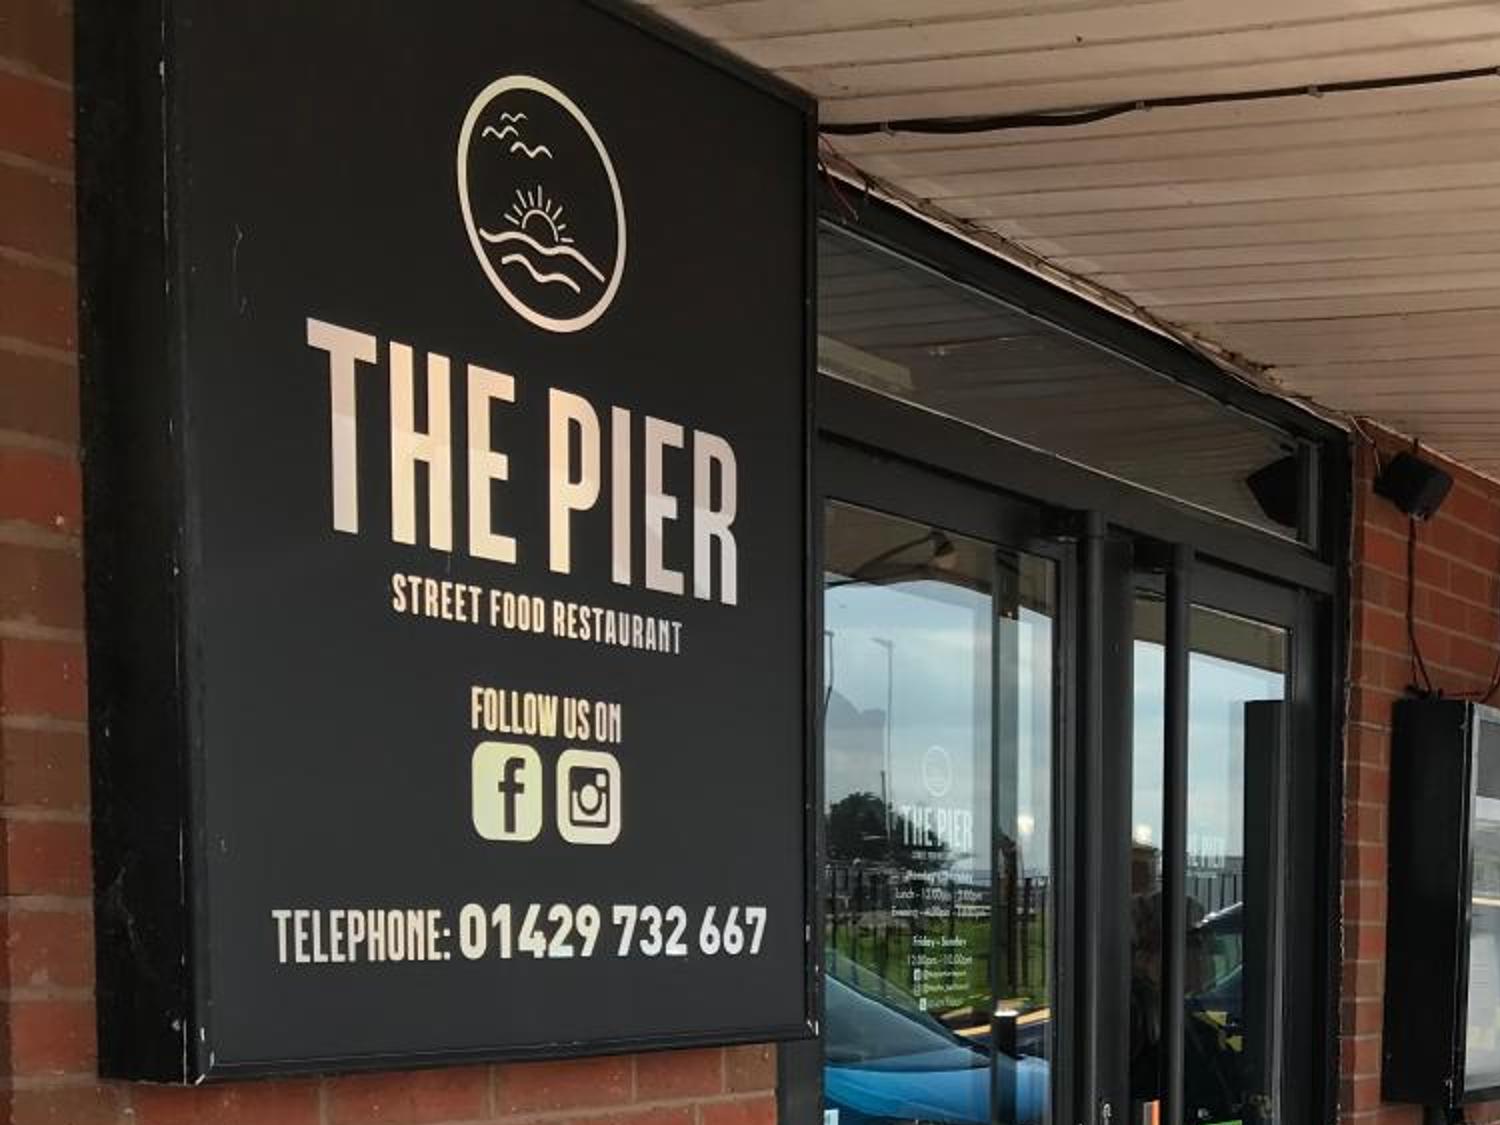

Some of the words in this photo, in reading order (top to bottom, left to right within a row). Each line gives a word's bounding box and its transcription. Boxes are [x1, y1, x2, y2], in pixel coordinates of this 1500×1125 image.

[306, 317, 517, 565] THE
[548, 387, 738, 606] PIER
[391, 572, 482, 625] STREET
[489, 588, 546, 635] FOOD
[552, 599, 684, 656] RESTAURANT
[471, 685, 559, 738] FOLLOW
[563, 696, 591, 741] US
[594, 700, 622, 744] ON
[900, 805, 934, 846] THE
[937, 808, 973, 853] PIER
[271, 908, 451, 964] TELEPHONE:
[459, 902, 602, 961] 01429
[612, 904, 689, 958] 732
[698, 905, 768, 956] 667
